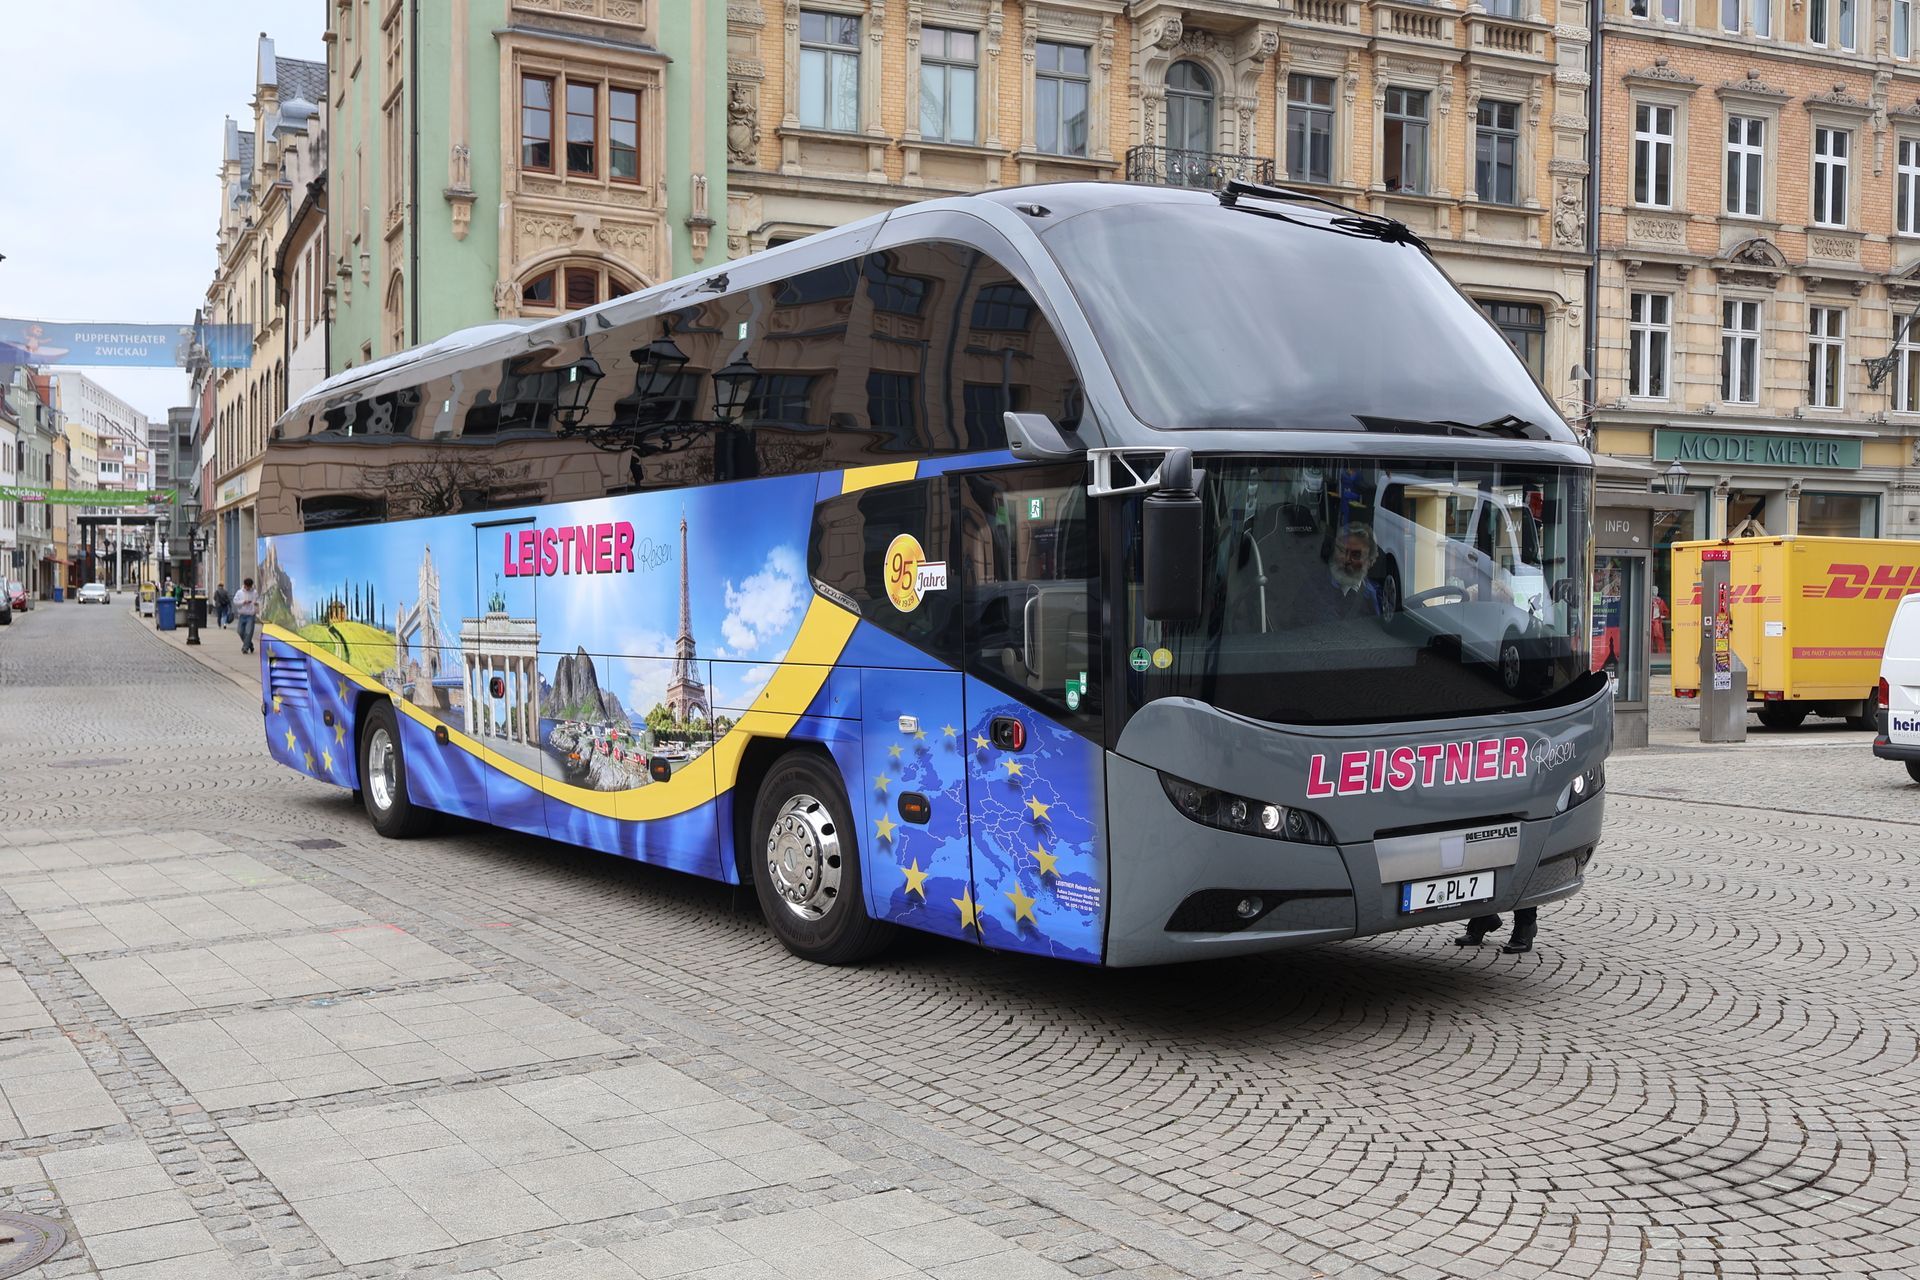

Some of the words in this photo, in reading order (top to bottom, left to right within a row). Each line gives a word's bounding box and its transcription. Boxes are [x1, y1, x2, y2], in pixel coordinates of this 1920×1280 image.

[75, 333, 166, 344] PUPPENTHEATER
[96, 346, 148, 356] ZWICKAU
[1679, 433, 1755, 462] MODE
[1765, 438, 1840, 466] MEYER
[1605, 519, 1630, 532] INFO
[504, 521, 635, 578] LEISTNER
[637, 537, 673, 573] Reisen
[891, 553, 914, 591] 95
[917, 572, 946, 592] Jahre
[1137, 649, 1144, 660] 4
[1306, 736, 1528, 800] LEISTNER
[1530, 737, 1577, 775] Reisen
[1465, 826, 1518, 842] NEOPLAN
[1426, 884, 1436, 904] Z
[1446, 880, 1465, 900] PL
[1470, 876, 1478, 897] 7
